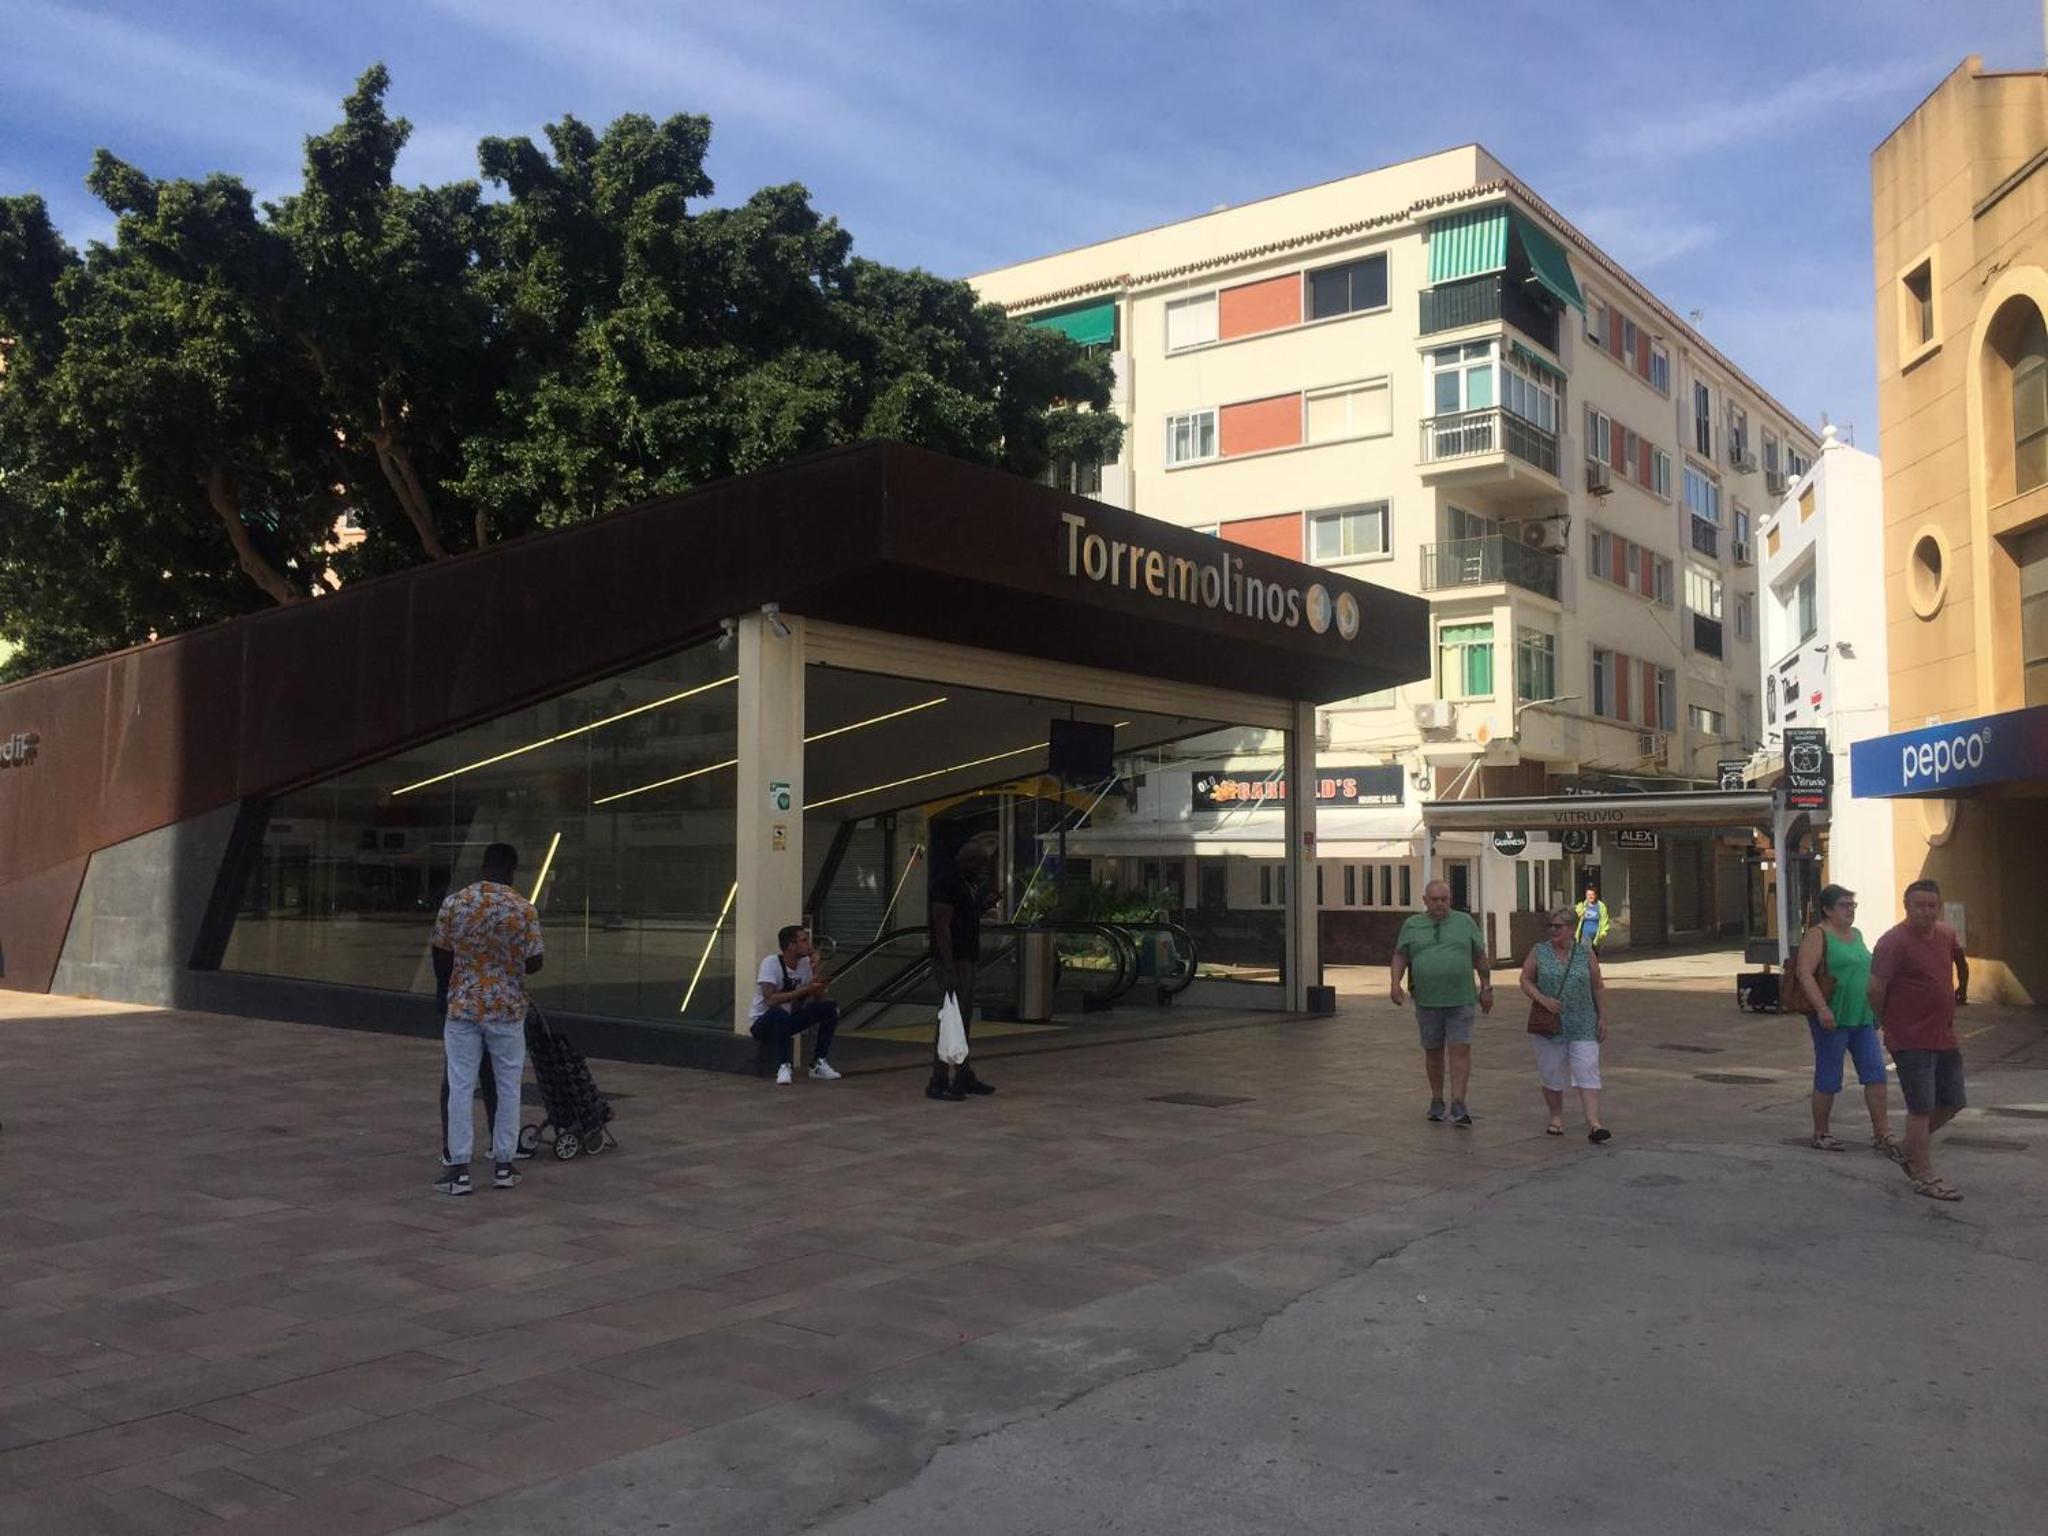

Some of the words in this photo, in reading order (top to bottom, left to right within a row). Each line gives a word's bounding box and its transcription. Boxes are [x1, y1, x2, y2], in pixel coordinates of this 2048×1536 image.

[1061, 512, 1300, 628] Torremolinos
[1196, 775, 1216, 793] OLD
[1553, 808, 1624, 823] VITRUVIO
[1621, 830, 1652, 841] ALEX
